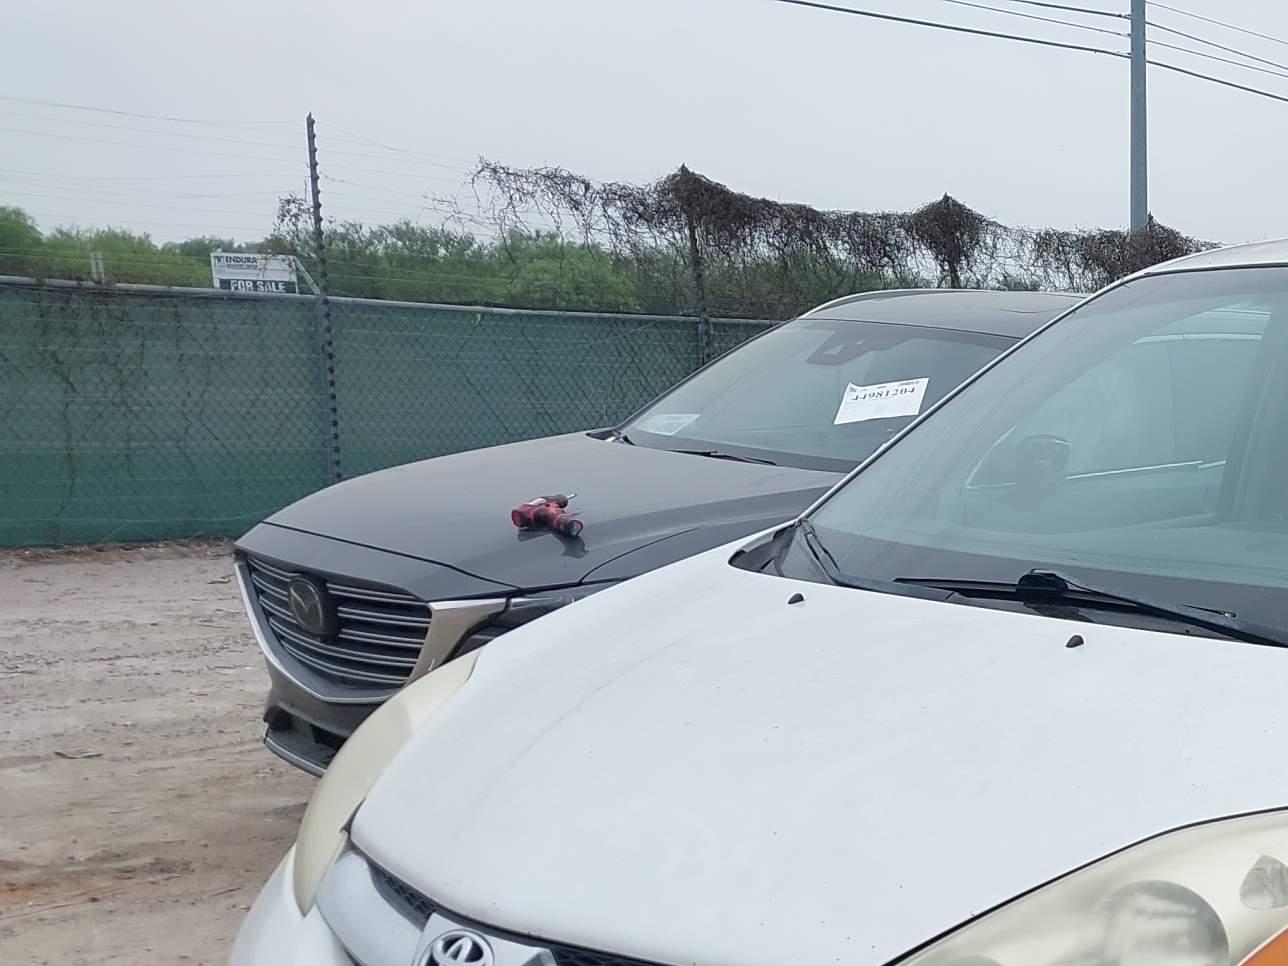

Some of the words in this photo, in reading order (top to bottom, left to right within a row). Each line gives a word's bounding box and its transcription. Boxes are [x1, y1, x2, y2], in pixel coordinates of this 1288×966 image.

[225, 255, 258, 264] ENDURA
[230, 279, 254, 292] FOR
[256, 281, 287, 293] SALE
[851, 386, 916, 401] 44981204
